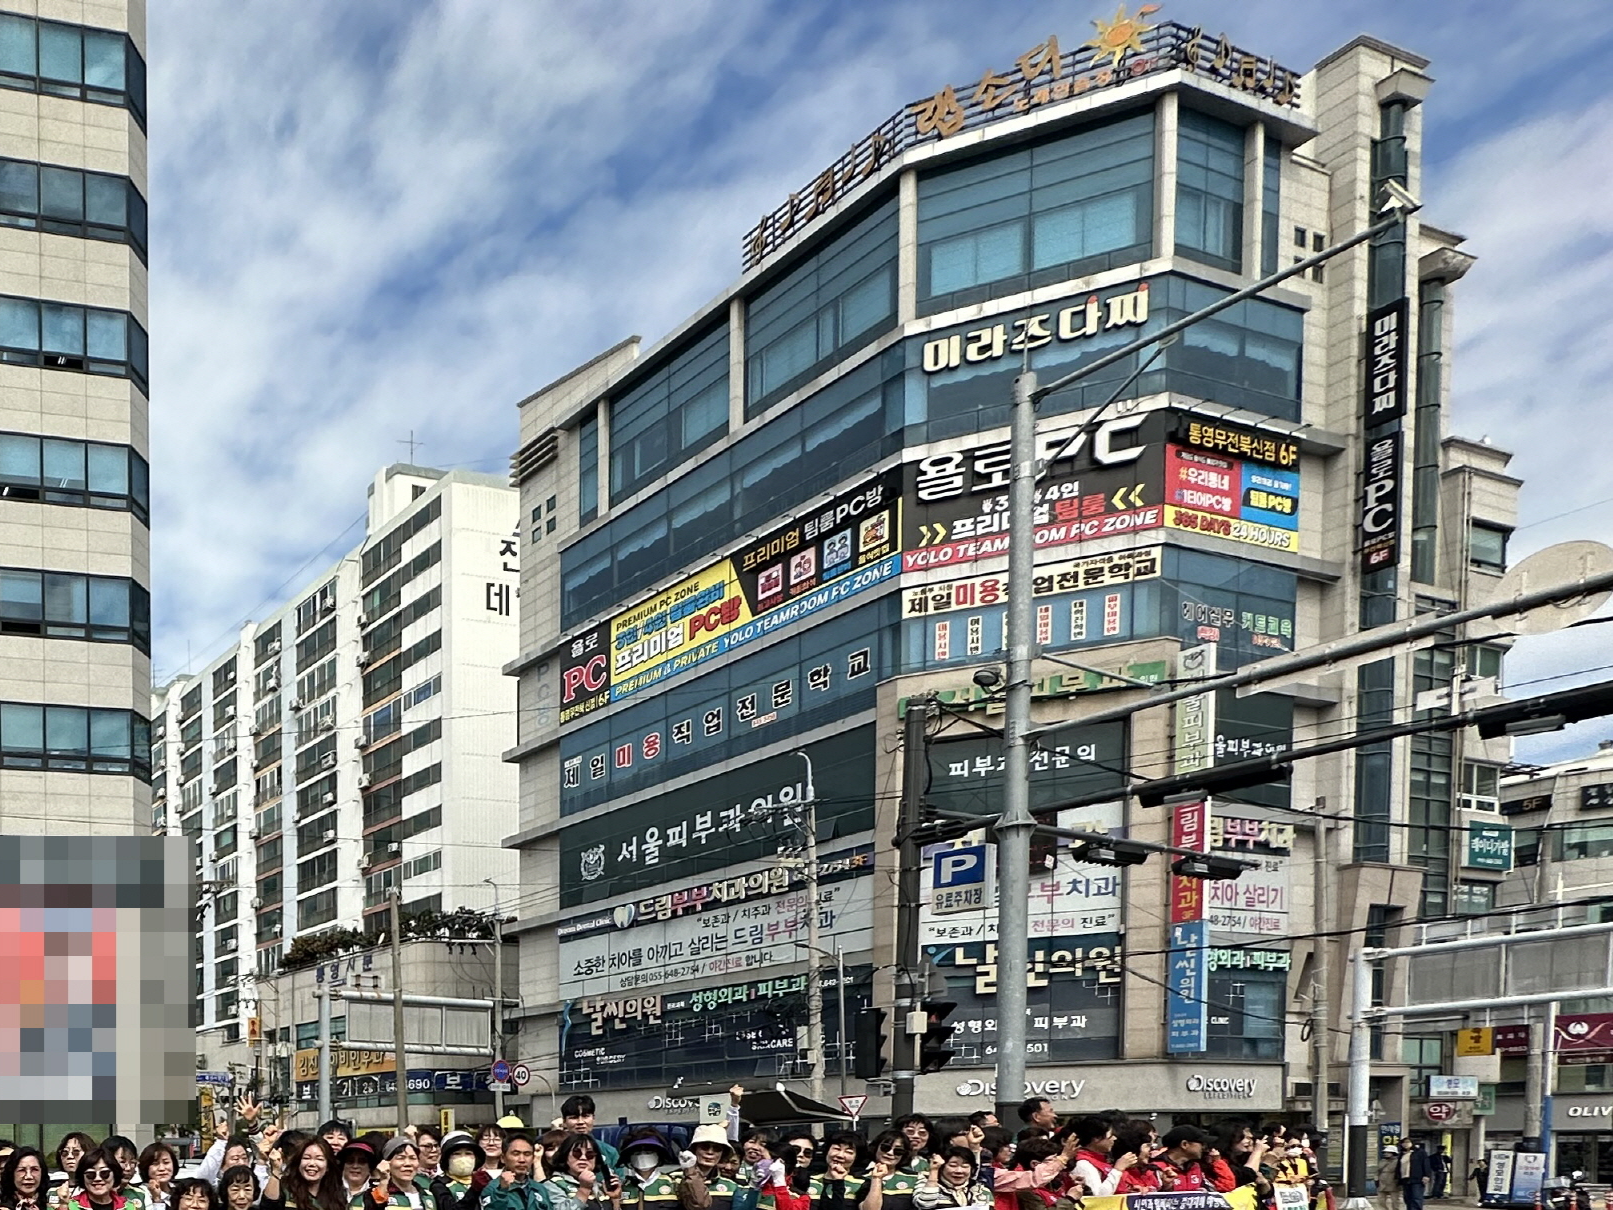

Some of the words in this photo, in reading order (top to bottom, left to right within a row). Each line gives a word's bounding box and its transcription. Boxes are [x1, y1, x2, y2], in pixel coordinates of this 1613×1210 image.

[1189, 423, 1276, 461] 통영무전북신점
[1280, 444, 1297, 466] 6F
[1055, 493, 1106, 521] 팀룸
[742, 528, 800, 572] 프리미엄
[905, 546, 953, 567] YOLO
[1071, 520, 1099, 538] PC
[1101, 508, 1159, 533] ZONE
[1232, 522, 1248, 540] 24
[1249, 526, 1291, 548] HOURS
[908, 558, 1157, 614] 제일미용업전문학교
[616, 604, 658, 631] PREMIUM
[660, 597, 672, 611] PC
[674, 582, 700, 603] ZONE
[571, 632, 598, 658] 욜로
[615, 668, 662, 697] PREMIUM
[673, 643, 719, 670] PRIVATE
[723, 626, 753, 648] YOLO
[831, 582, 850, 600] PC
[852, 561, 893, 590] ZONE
[615, 623, 684, 676] 프리미엄
[689, 595, 742, 641] PC방
[563, 655, 607, 703] PC
[940, 854, 977, 884] P
[935, 888, 983, 909] 유료주차장
[1211, 881, 1239, 906] 치아
[1243, 884, 1284, 909] 살리기
[1032, 917, 1074, 932] 전문의
[573, 956, 605, 976] 소중한
[609, 948, 643, 969] 치아를
[647, 942, 684, 962] 아끼고
[688, 933, 728, 956] 살리는
[689, 984, 749, 1012] 성형외과
[757, 974, 808, 1000] 피부과
[1034, 1015, 1088, 1030] 피부과
[516, 1071, 527, 1080] 40
[1429, 1105, 1450, 1119] 약
